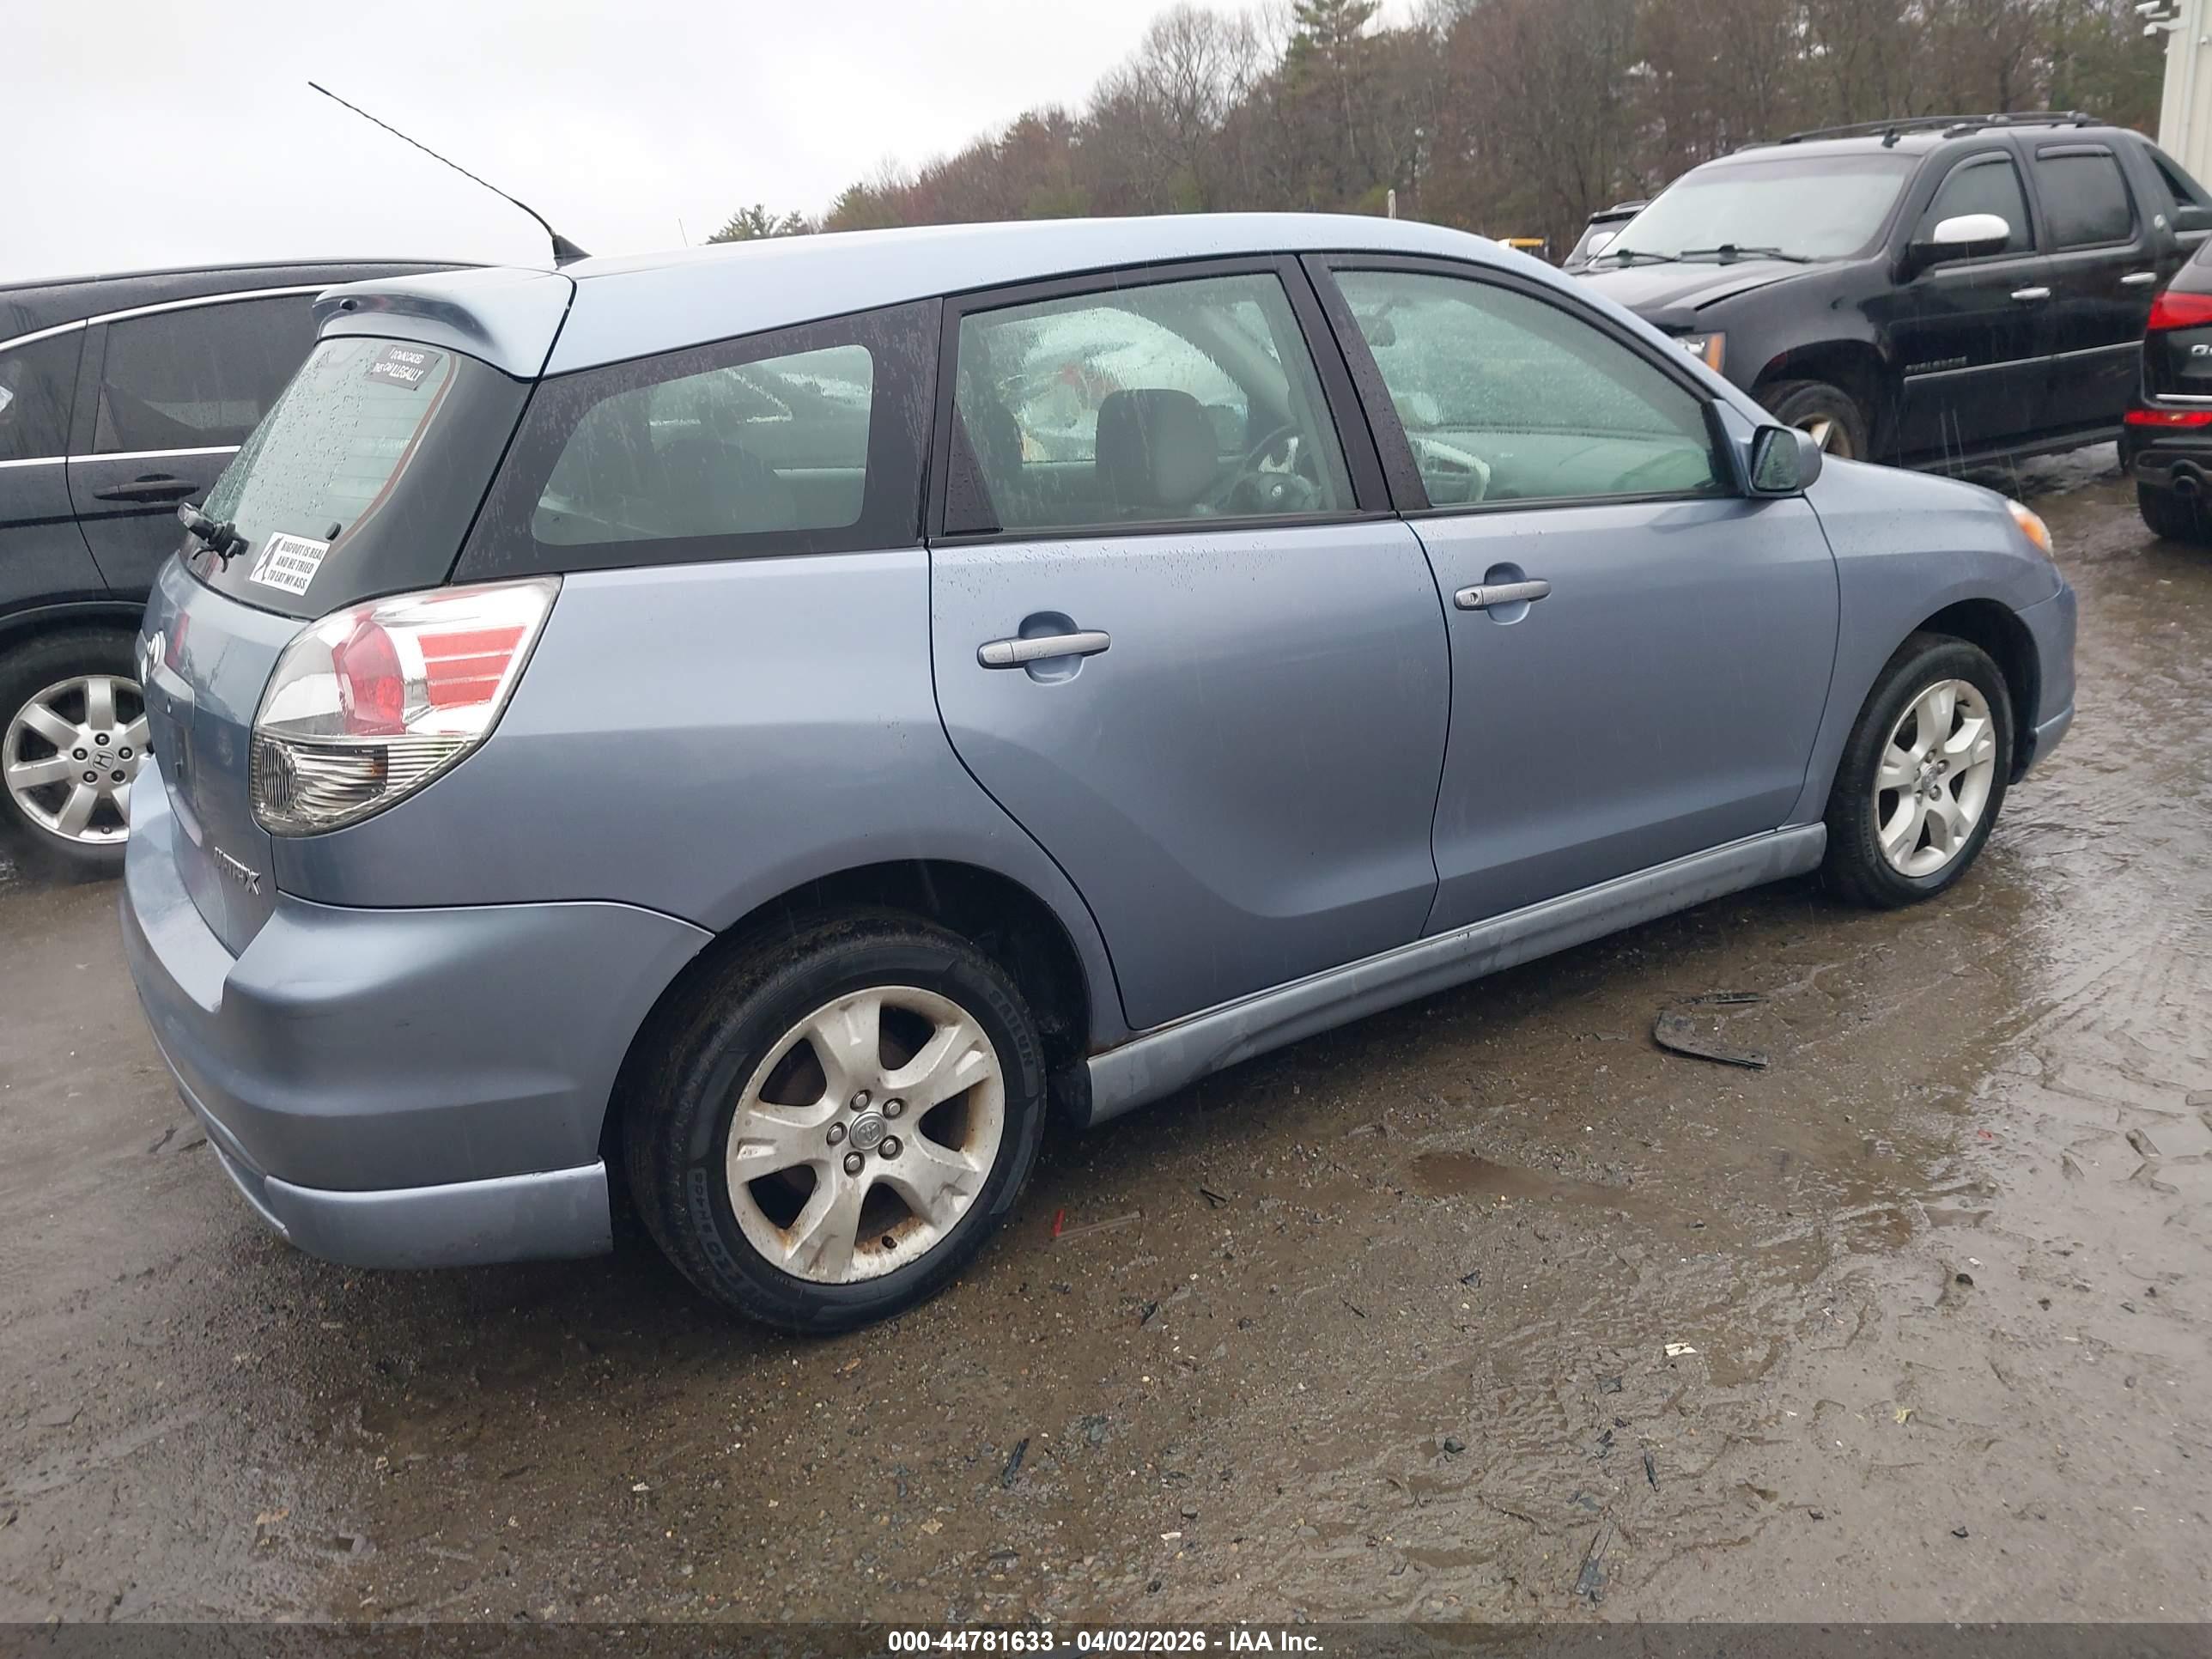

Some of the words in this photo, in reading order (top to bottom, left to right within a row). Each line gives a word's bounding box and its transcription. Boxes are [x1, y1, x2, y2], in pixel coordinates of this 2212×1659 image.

[389, 363, 424, 382] ILLEGALLY
[280, 541, 303, 556] BIGFOOT
[308, 547, 325, 561] REAL
[276, 556, 289, 568] AND
[289, 558, 297, 570] HE
[295, 560, 315, 574] TRIED
[267, 569, 276, 581] TO
[274, 572, 287, 585] EAT
[283, 575, 296, 587] MY
[293, 577, 308, 590] ASS
